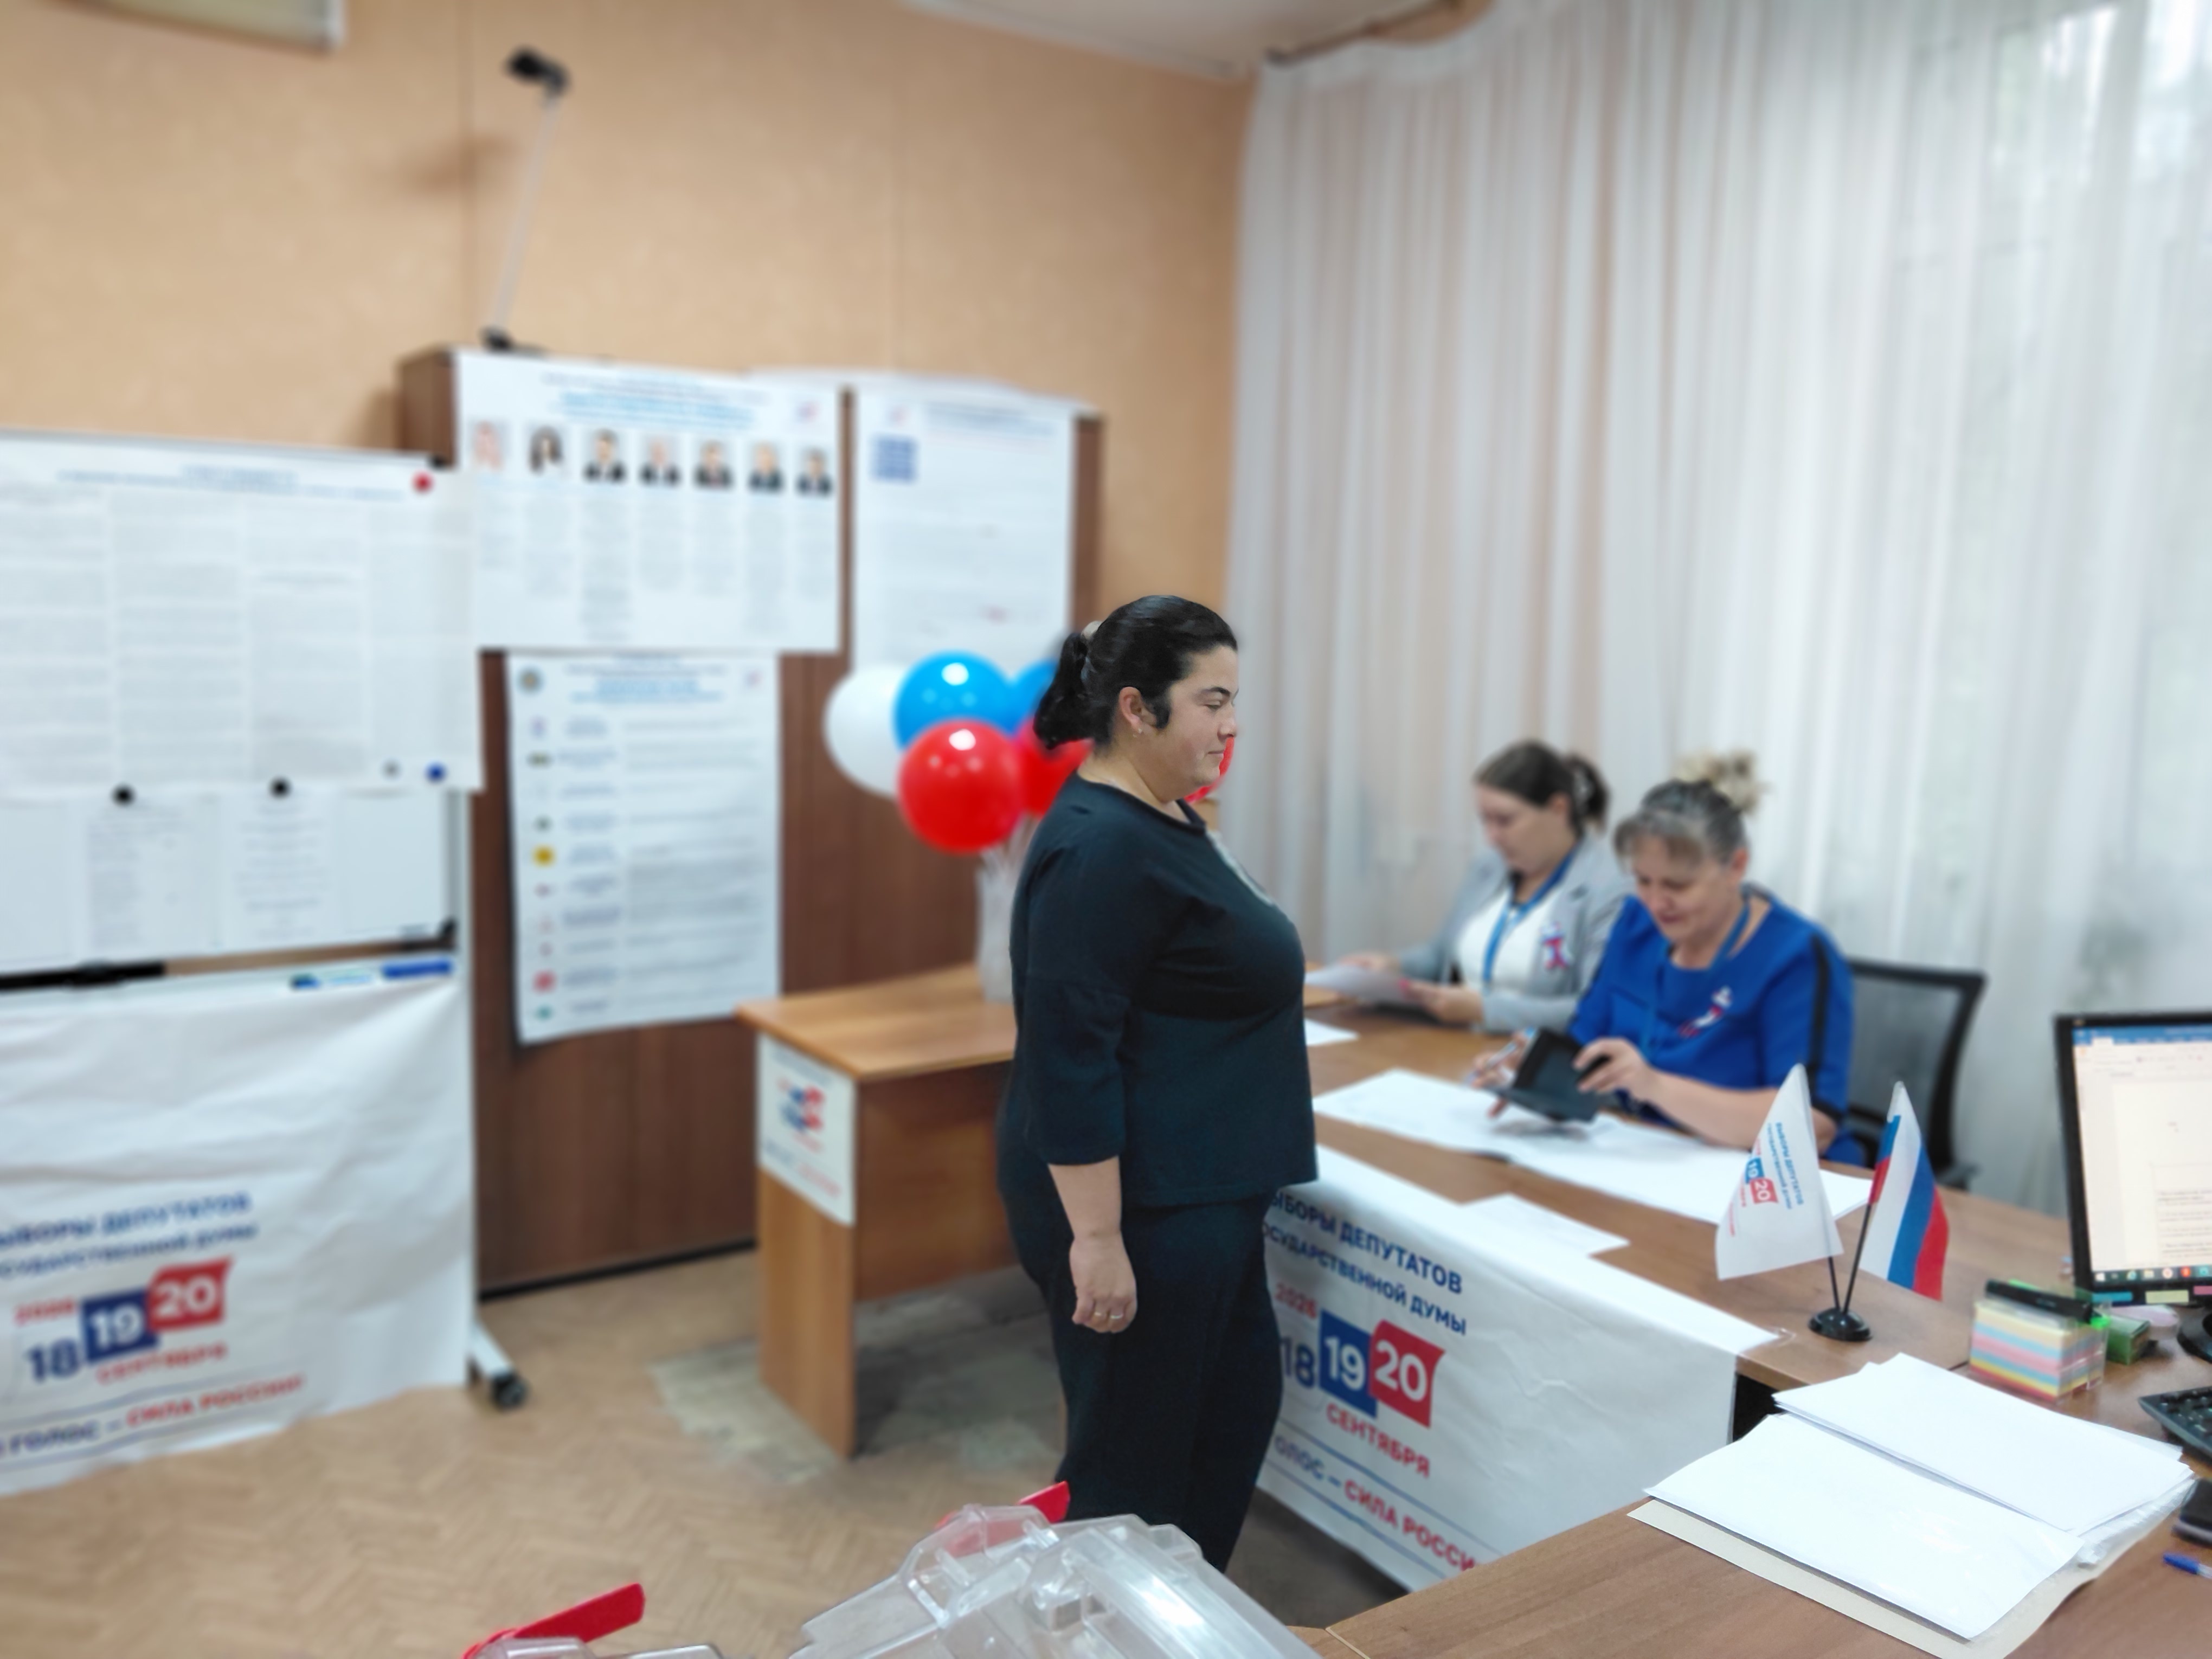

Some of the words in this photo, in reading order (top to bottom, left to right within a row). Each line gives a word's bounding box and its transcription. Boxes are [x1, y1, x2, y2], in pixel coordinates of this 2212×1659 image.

[1747, 1160, 1759, 1178] 19
[1754, 1180, 1771, 1201] 20
[1339, 1221, 1463, 1295] ДЕПУТАТОВ
[25, 1337, 81, 1382] 18
[89, 1305, 145, 1350] 19
[153, 1276, 218, 1320] 20
[1410, 1295, 1466, 1335] ДУМЫ
[1281, 1336, 1315, 1390] 18
[1324, 1336, 1366, 1391] 19
[1374, 1339, 1427, 1401] 20
[1326, 1403, 1430, 1478] СЕНТЯБРЯ
[1344, 1480, 1398, 1528] СИЛА
